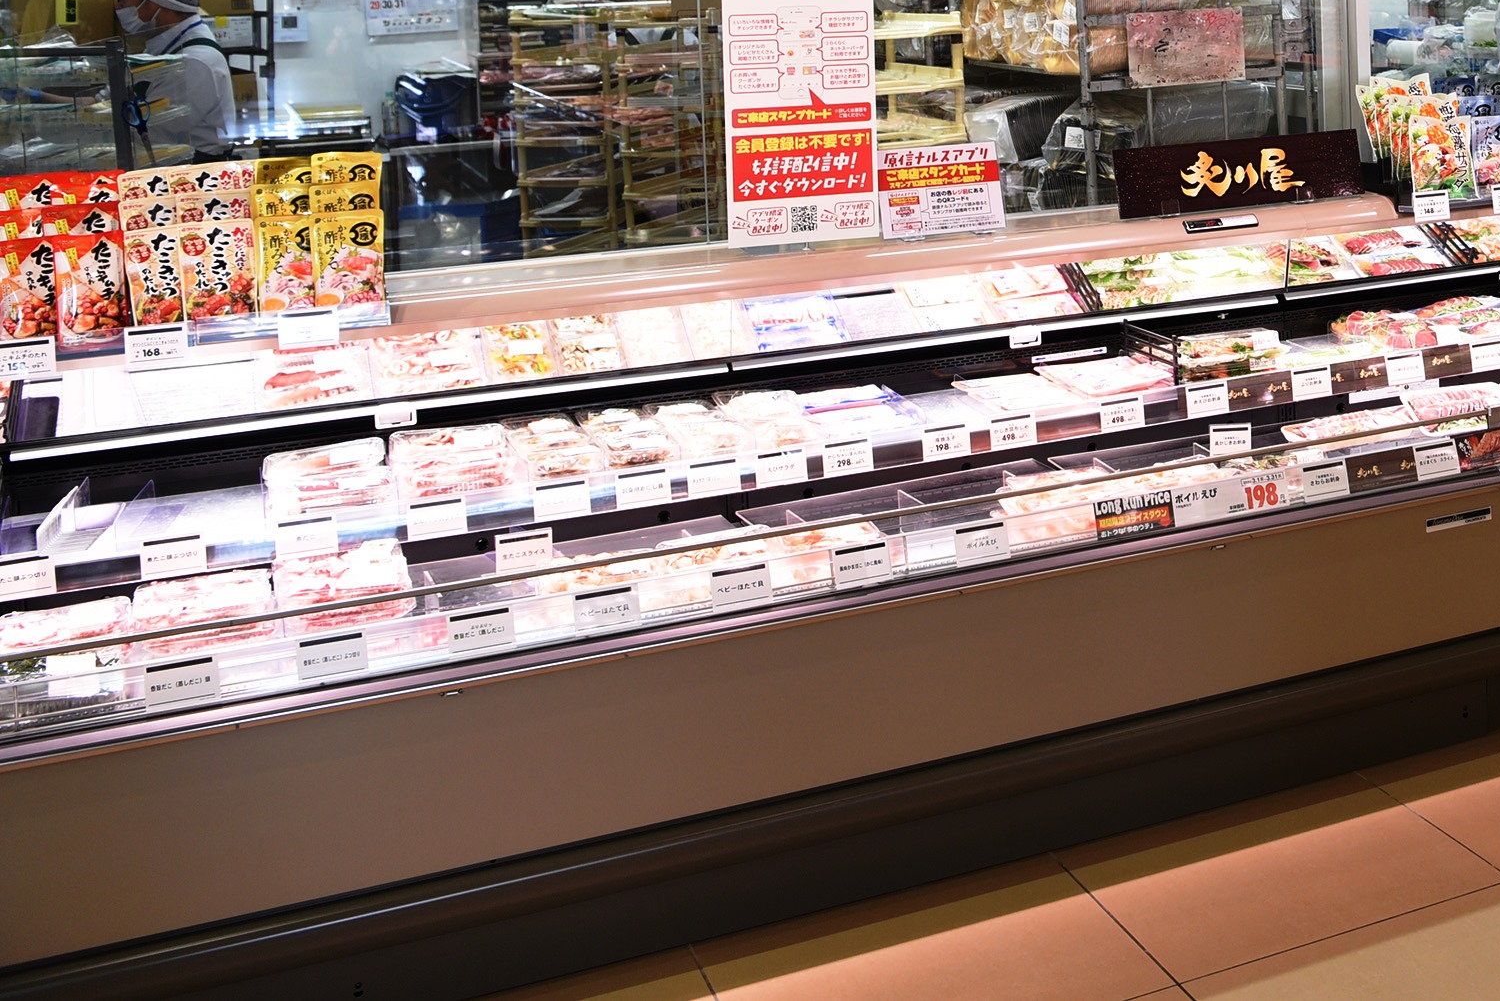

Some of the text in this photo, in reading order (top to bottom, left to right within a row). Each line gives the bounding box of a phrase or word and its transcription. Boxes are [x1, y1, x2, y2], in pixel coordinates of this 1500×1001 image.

[370, 0, 404, 10] 29 30 31
[735, 132, 870, 154] 会員登録は不要です!
[752, 152, 858, 176] 好評配信中!
[884, 147, 988, 168] 原信ナルスアプリ
[1181, 148, 1305, 197] 炙り屋
[738, 173, 867, 197] 今すぐダウンロード!
[0, 352, 48, 362] こキムチのたれ
[142, 348, 160, 357] 168
[1112, 416, 1125, 424] 498
[1002, 433, 1016, 442] 498
[936, 443, 950, 452] 198
[837, 458, 852, 468] 298
[1095, 491, 1171, 516] Long Run Price
[1175, 487, 1218, 505] ボイルえび
[1244, 483, 1279, 510] 198
[717, 581, 765, 594] ベビーほたて貝
